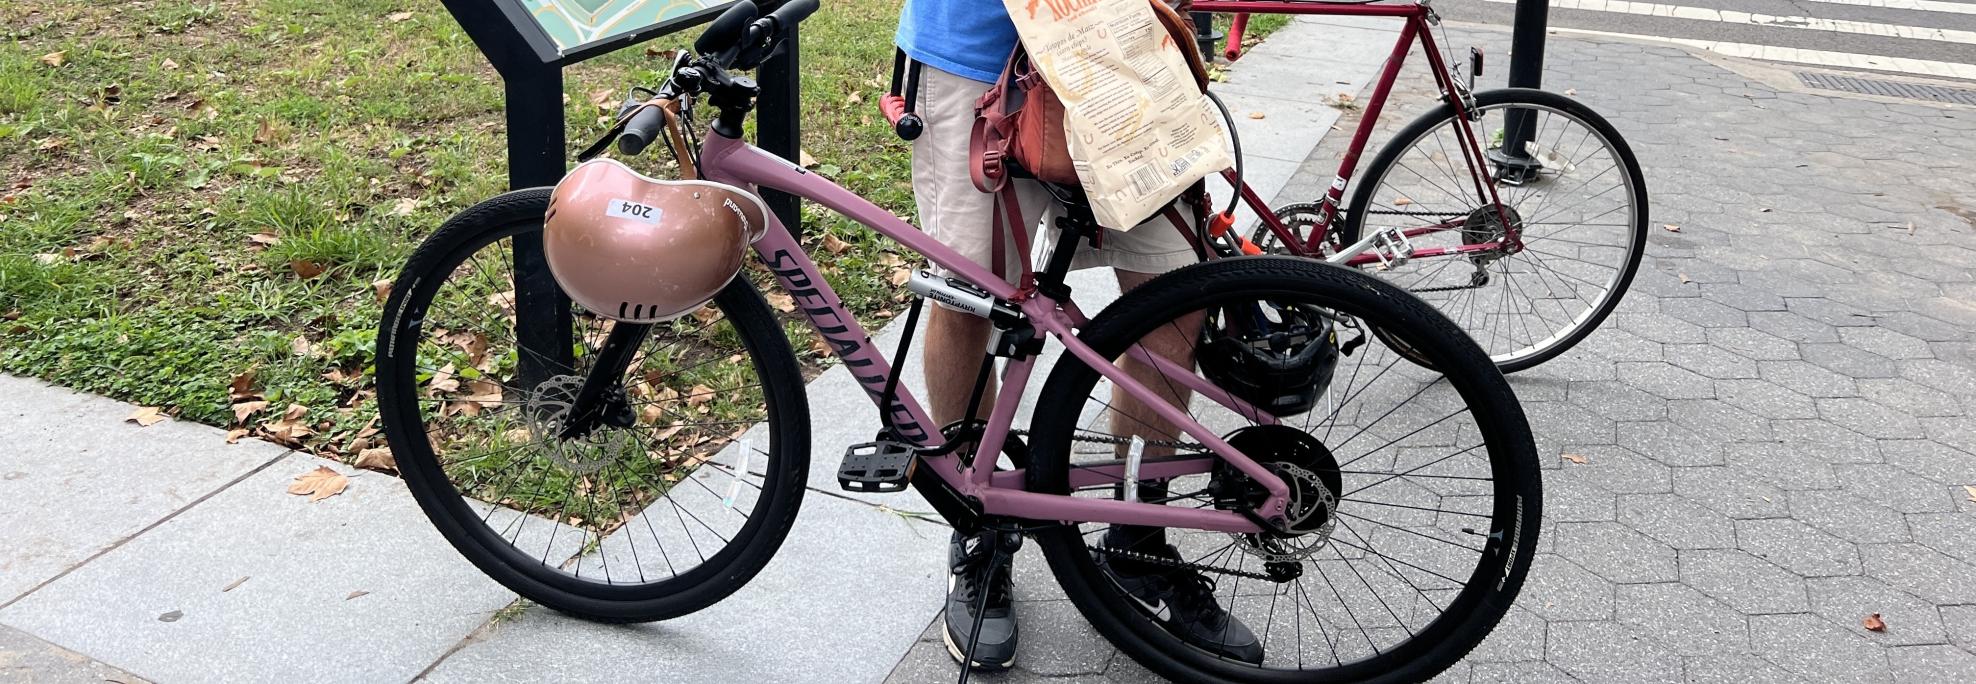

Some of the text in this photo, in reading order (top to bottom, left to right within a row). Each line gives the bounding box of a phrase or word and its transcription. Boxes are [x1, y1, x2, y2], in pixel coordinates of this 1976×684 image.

[622, 201, 653, 219] 204
[929, 292, 976, 313] KRYPTONITE
[757, 249, 929, 443] SPECIALIZED
[1505, 549, 1517, 572] SPORT
